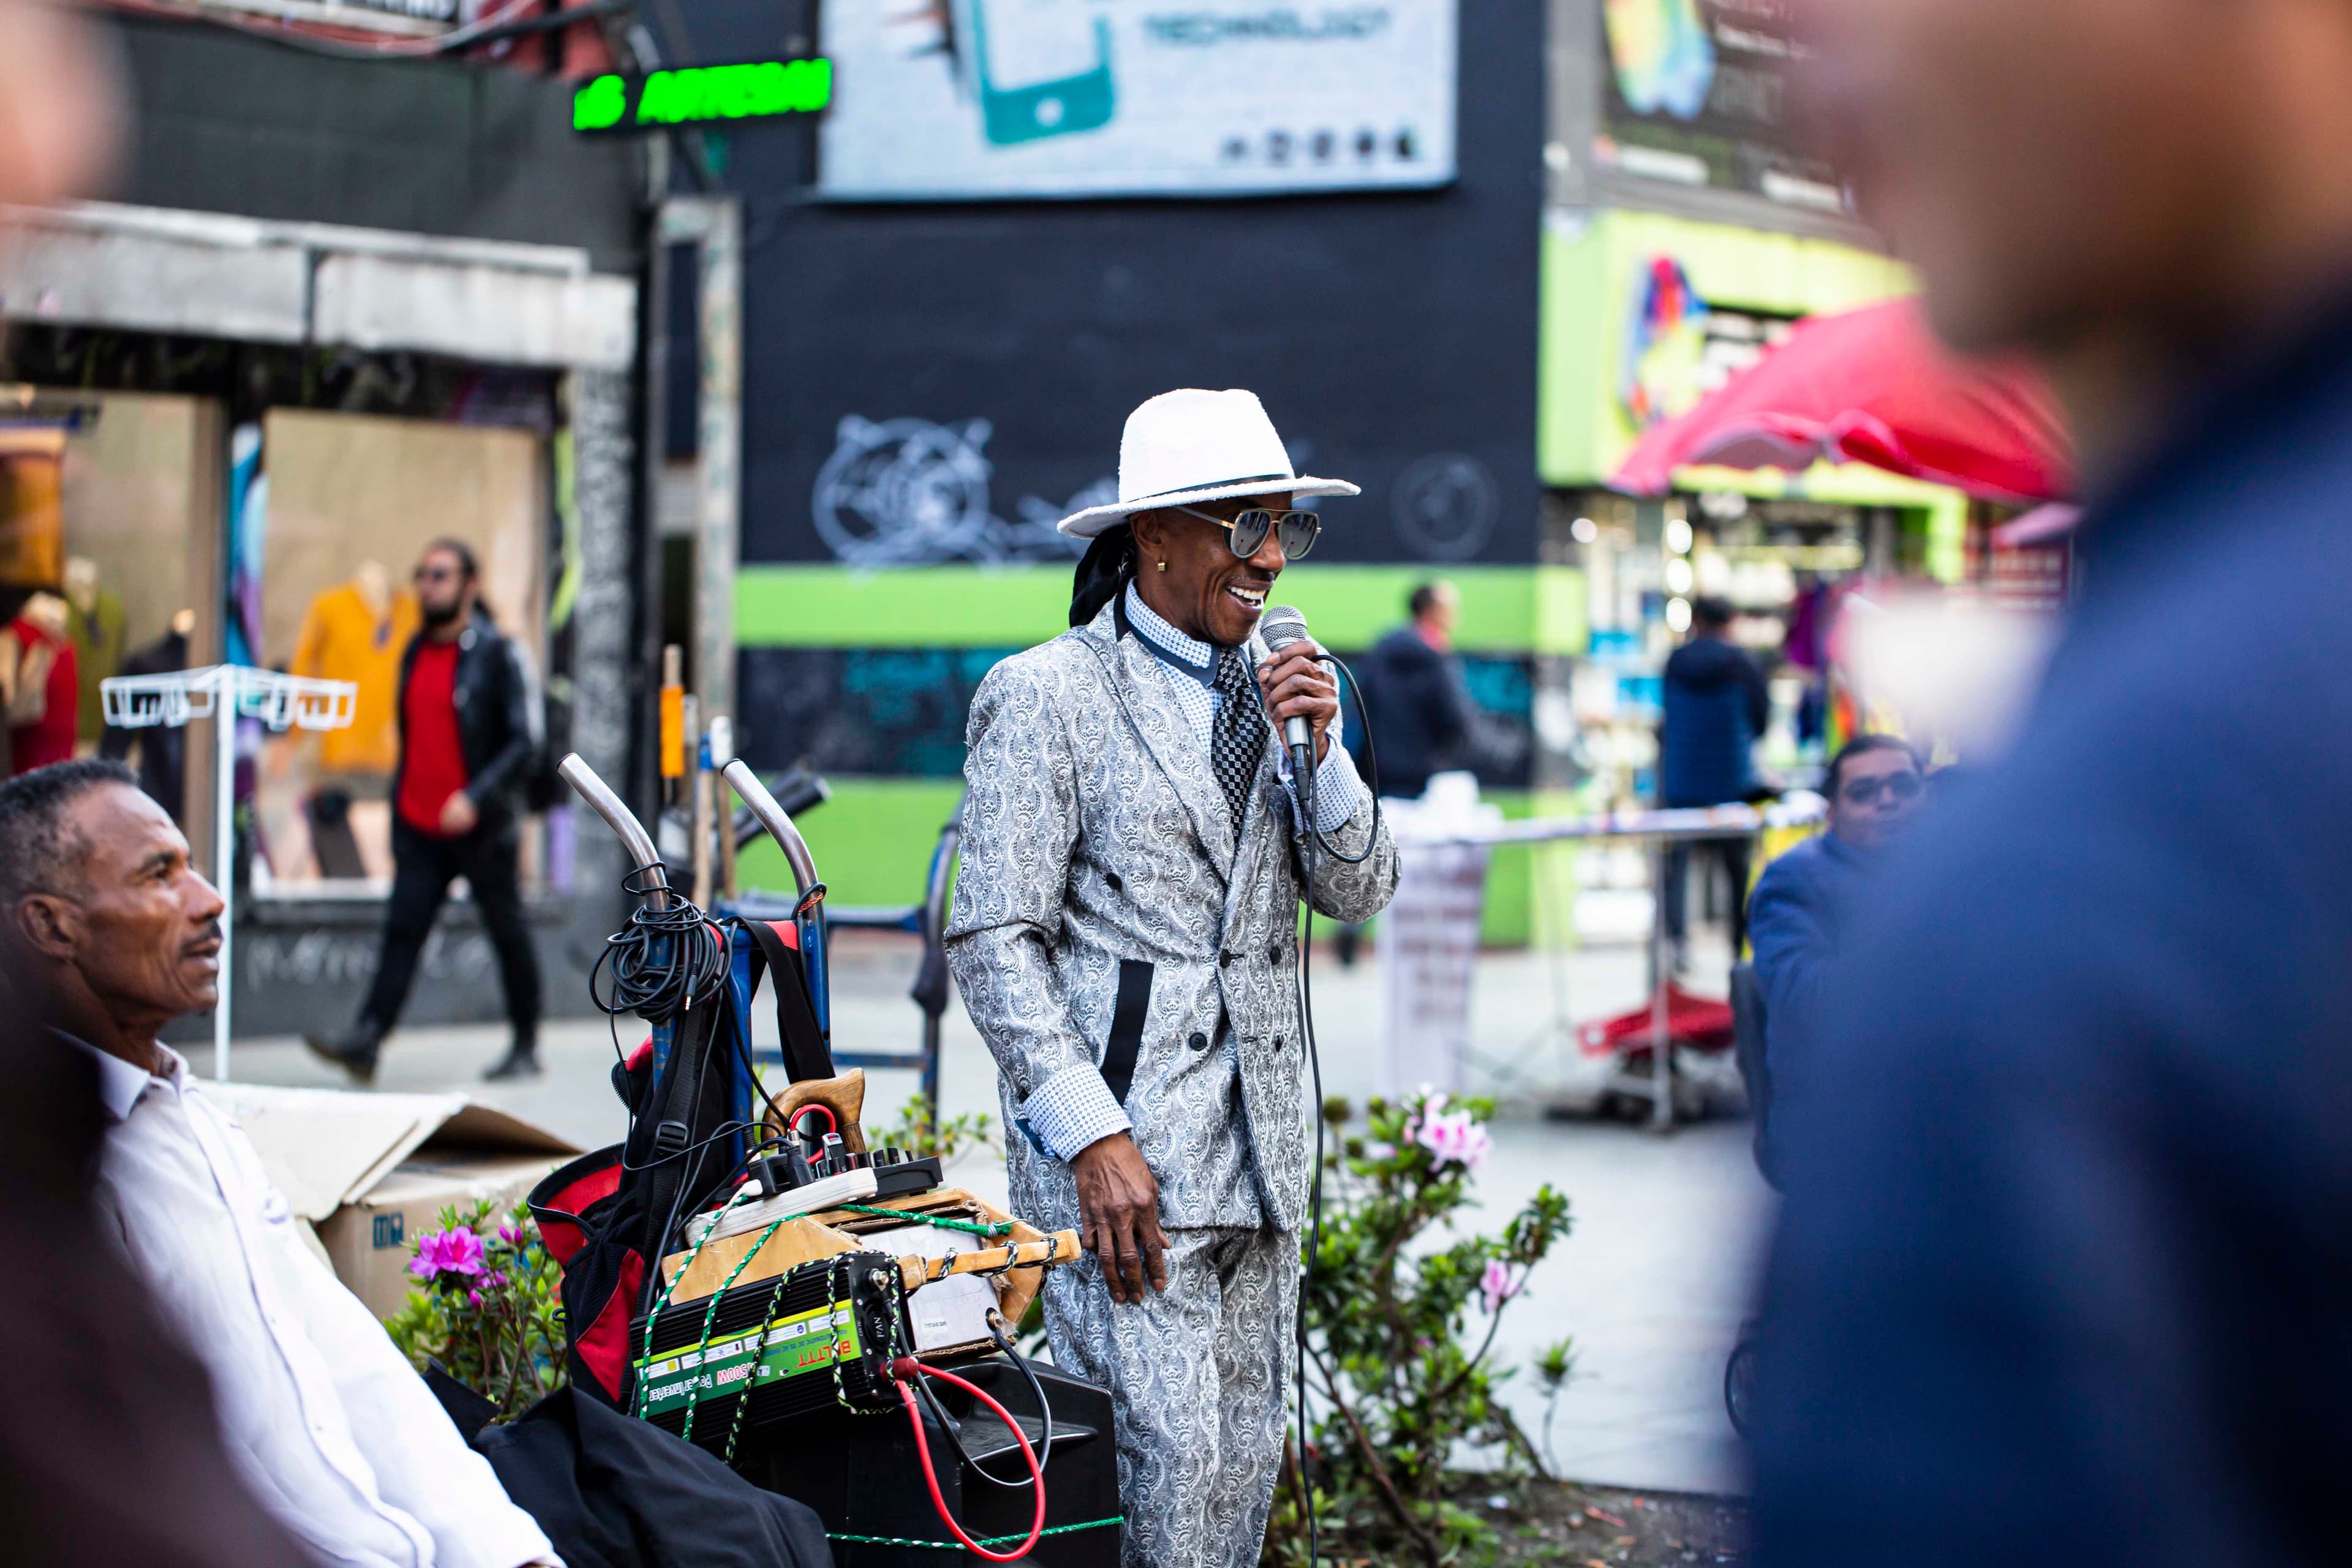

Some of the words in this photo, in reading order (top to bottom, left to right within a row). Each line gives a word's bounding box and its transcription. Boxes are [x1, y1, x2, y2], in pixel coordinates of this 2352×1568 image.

[873, 1317, 885, 1337] FAN
[649, 1381, 685, 1401] Inverter
[684, 1374, 713, 1392] Poer
